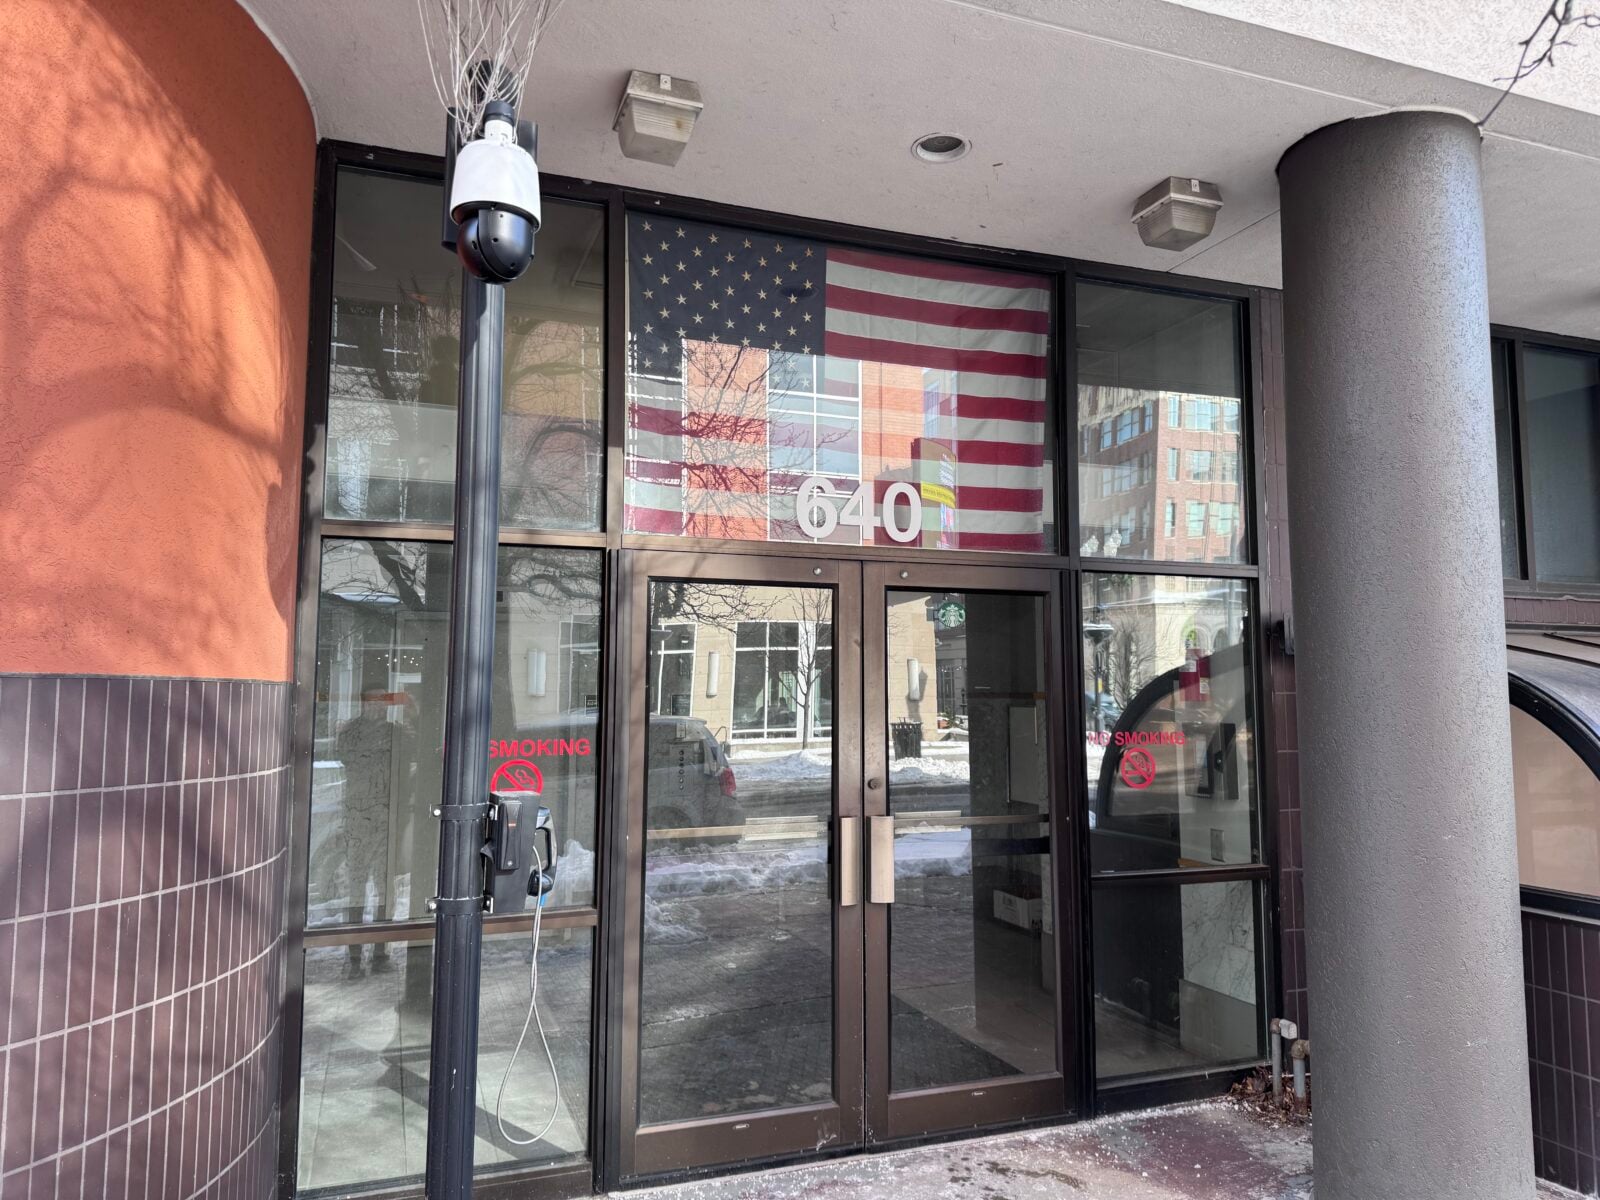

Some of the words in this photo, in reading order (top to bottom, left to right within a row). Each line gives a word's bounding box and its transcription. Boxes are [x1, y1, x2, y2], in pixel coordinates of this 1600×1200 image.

[797, 476, 922, 543] 640
[489, 738, 591, 759] SMOKING
[1088, 731, 1111, 747] NO
[1115, 731, 1185, 746] SMOKING
